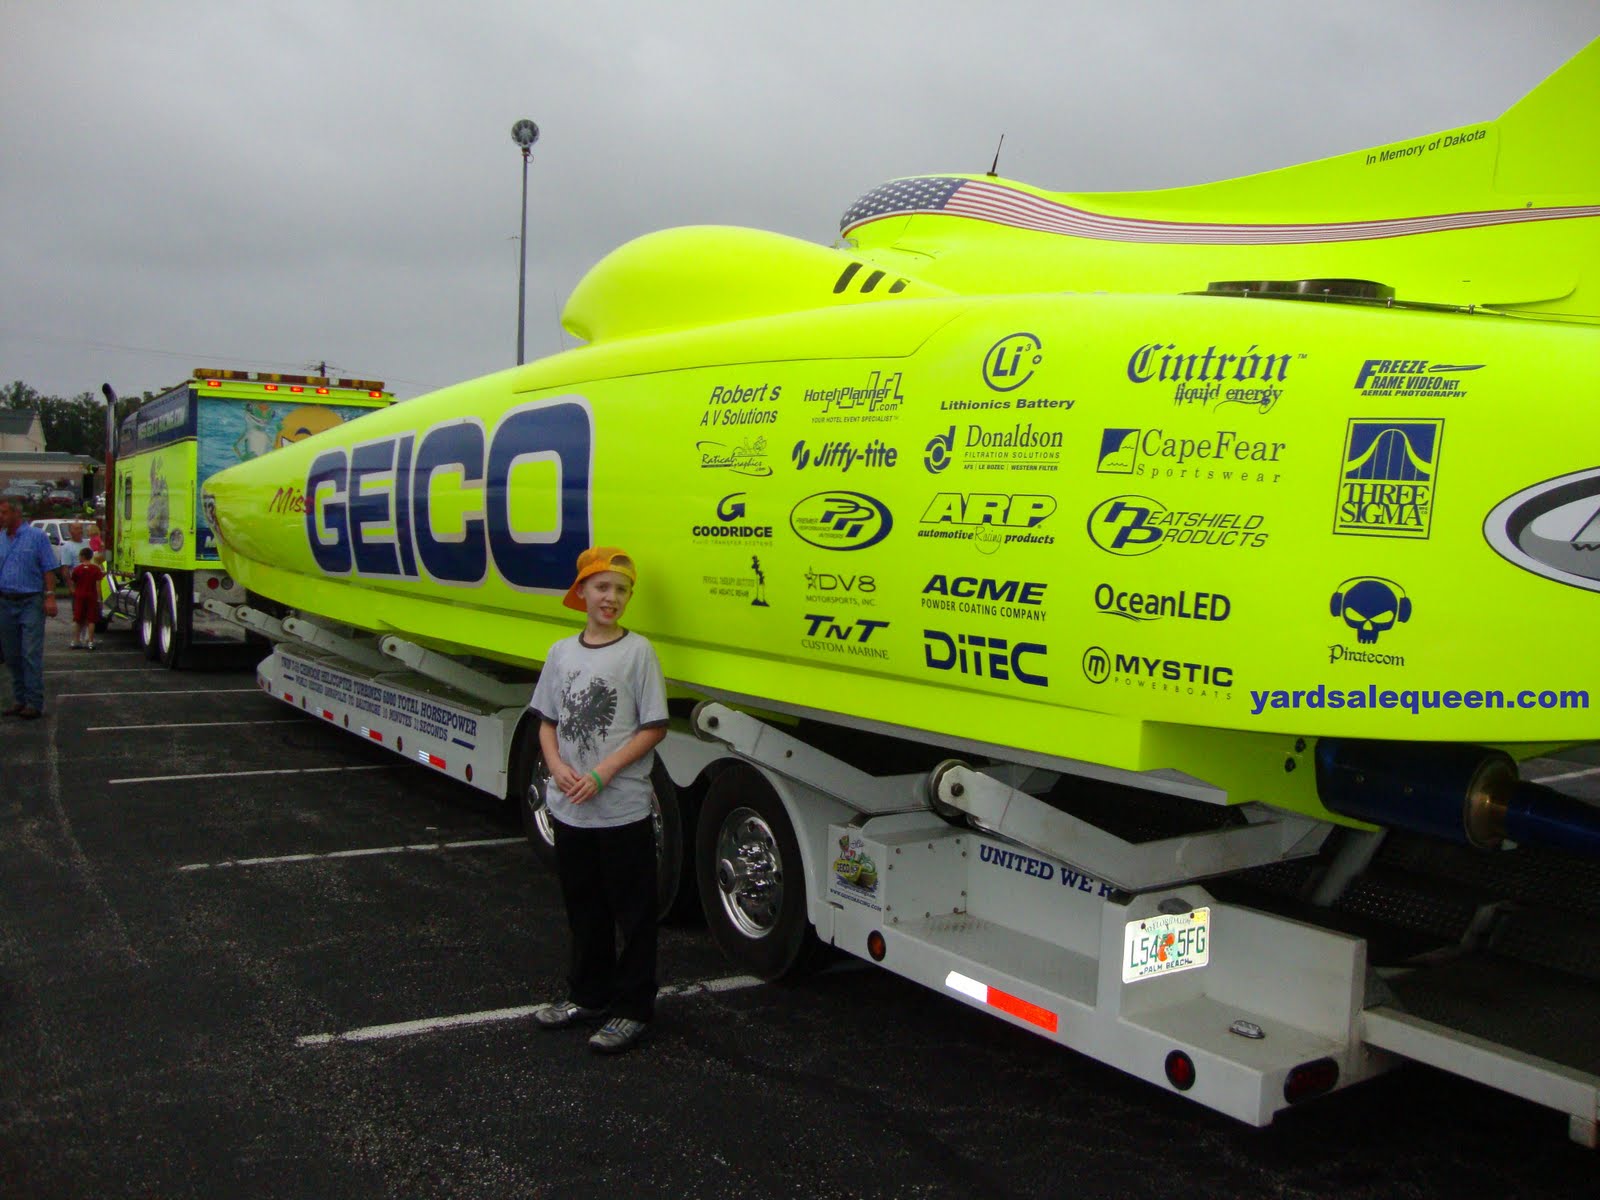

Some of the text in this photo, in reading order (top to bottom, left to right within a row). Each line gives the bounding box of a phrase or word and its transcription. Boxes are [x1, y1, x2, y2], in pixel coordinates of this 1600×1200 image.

[1366, 129, 1486, 165] In Memory of Dakota
[1127, 343, 1293, 383] Cintrón
[940, 398, 1075, 411] Lithionics Battery
[1174, 382, 1284, 414] liquid energy
[1395, 390, 1467, 398] PHOTOGRAPHY
[700, 407, 778, 427] A V Solutions
[861, 415, 893, 423] SPECIALIST
[966, 423, 1063, 448] Donaldson
[813, 439, 898, 472] Jiffy-tite
[964, 451, 1009, 459] FILTRATION
[1136, 464, 1281, 483] Sportswear
[269, 486, 312, 515] Miss
[304, 394, 594, 596] GEICO
[1342, 483, 1430, 506] THREE
[919, 492, 1057, 528] ARP
[1340, 502, 1424, 527] SIGMA
[692, 525, 773, 538] GOODRIDGE
[918, 529, 974, 541] automotive
[1004, 532, 1055, 545] products
[922, 574, 1048, 605] ACME
[921, 598, 1046, 622] POWDER COATING COMPANY
[1094, 583, 1231, 622] OceanLED
[801, 639, 889, 660] CUSTOM MARINE
[1328, 644, 1404, 667] Piratecom
[1115, 654, 1233, 687] MYSTIC
[1115, 676, 1232, 700] POWERBOATS
[398, 694, 419, 715] TOTAL
[420, 702, 477, 737] HORSEPOWER
[420, 720, 448, 742] SECONDS
[980, 844, 1054, 881] UNITED
[1061, 867, 1094, 893] WE
[1177, 926, 1206, 958] 5FG
[1143, 957, 1190, 975] PALM BEACH
